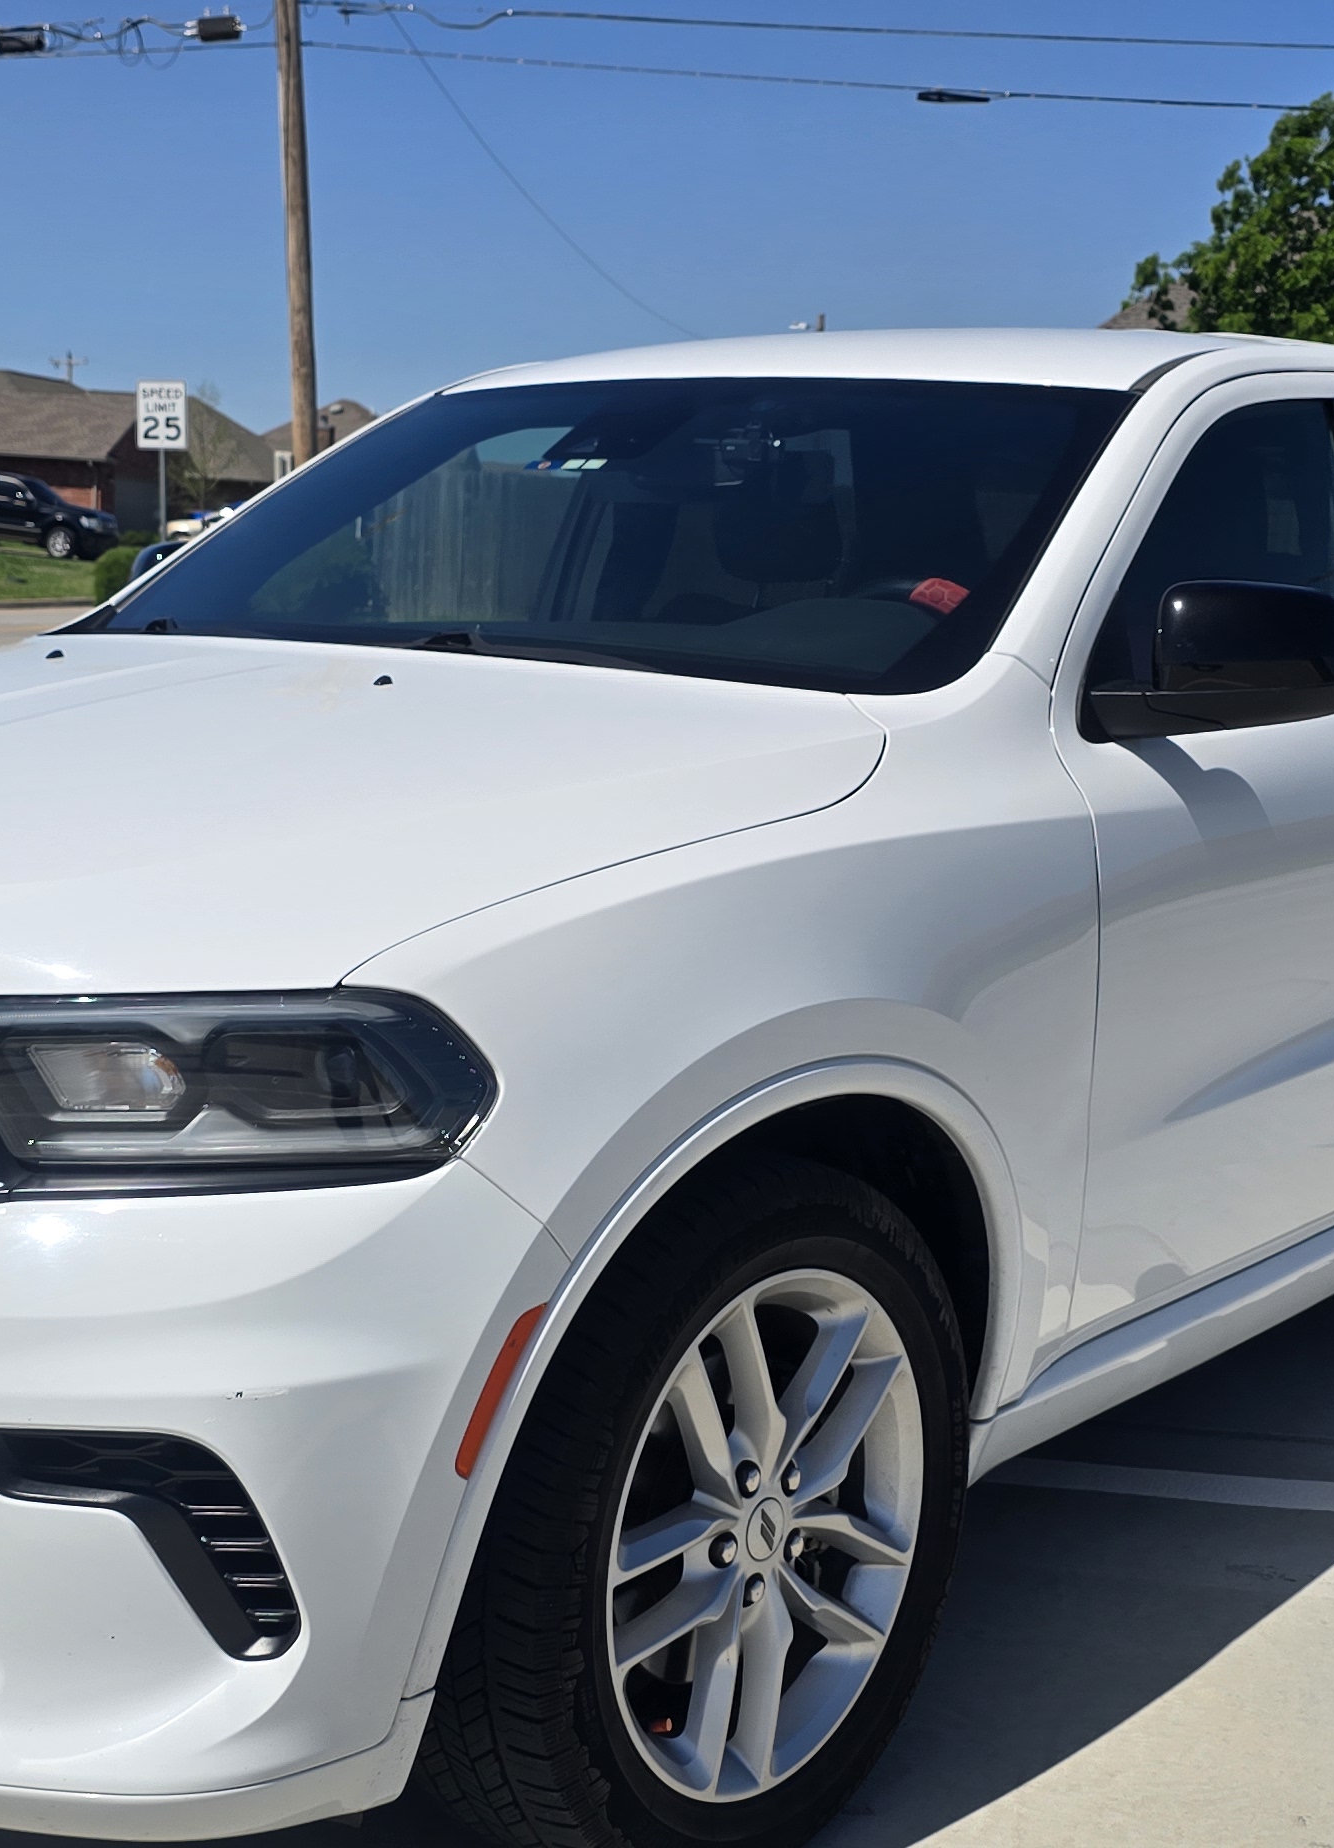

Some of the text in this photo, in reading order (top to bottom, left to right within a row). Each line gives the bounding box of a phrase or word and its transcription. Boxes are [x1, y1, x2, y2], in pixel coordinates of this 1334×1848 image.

[142, 387, 183, 399] SPEED
[145, 402, 177, 413] LIMIT
[143, 416, 181, 441] 25
